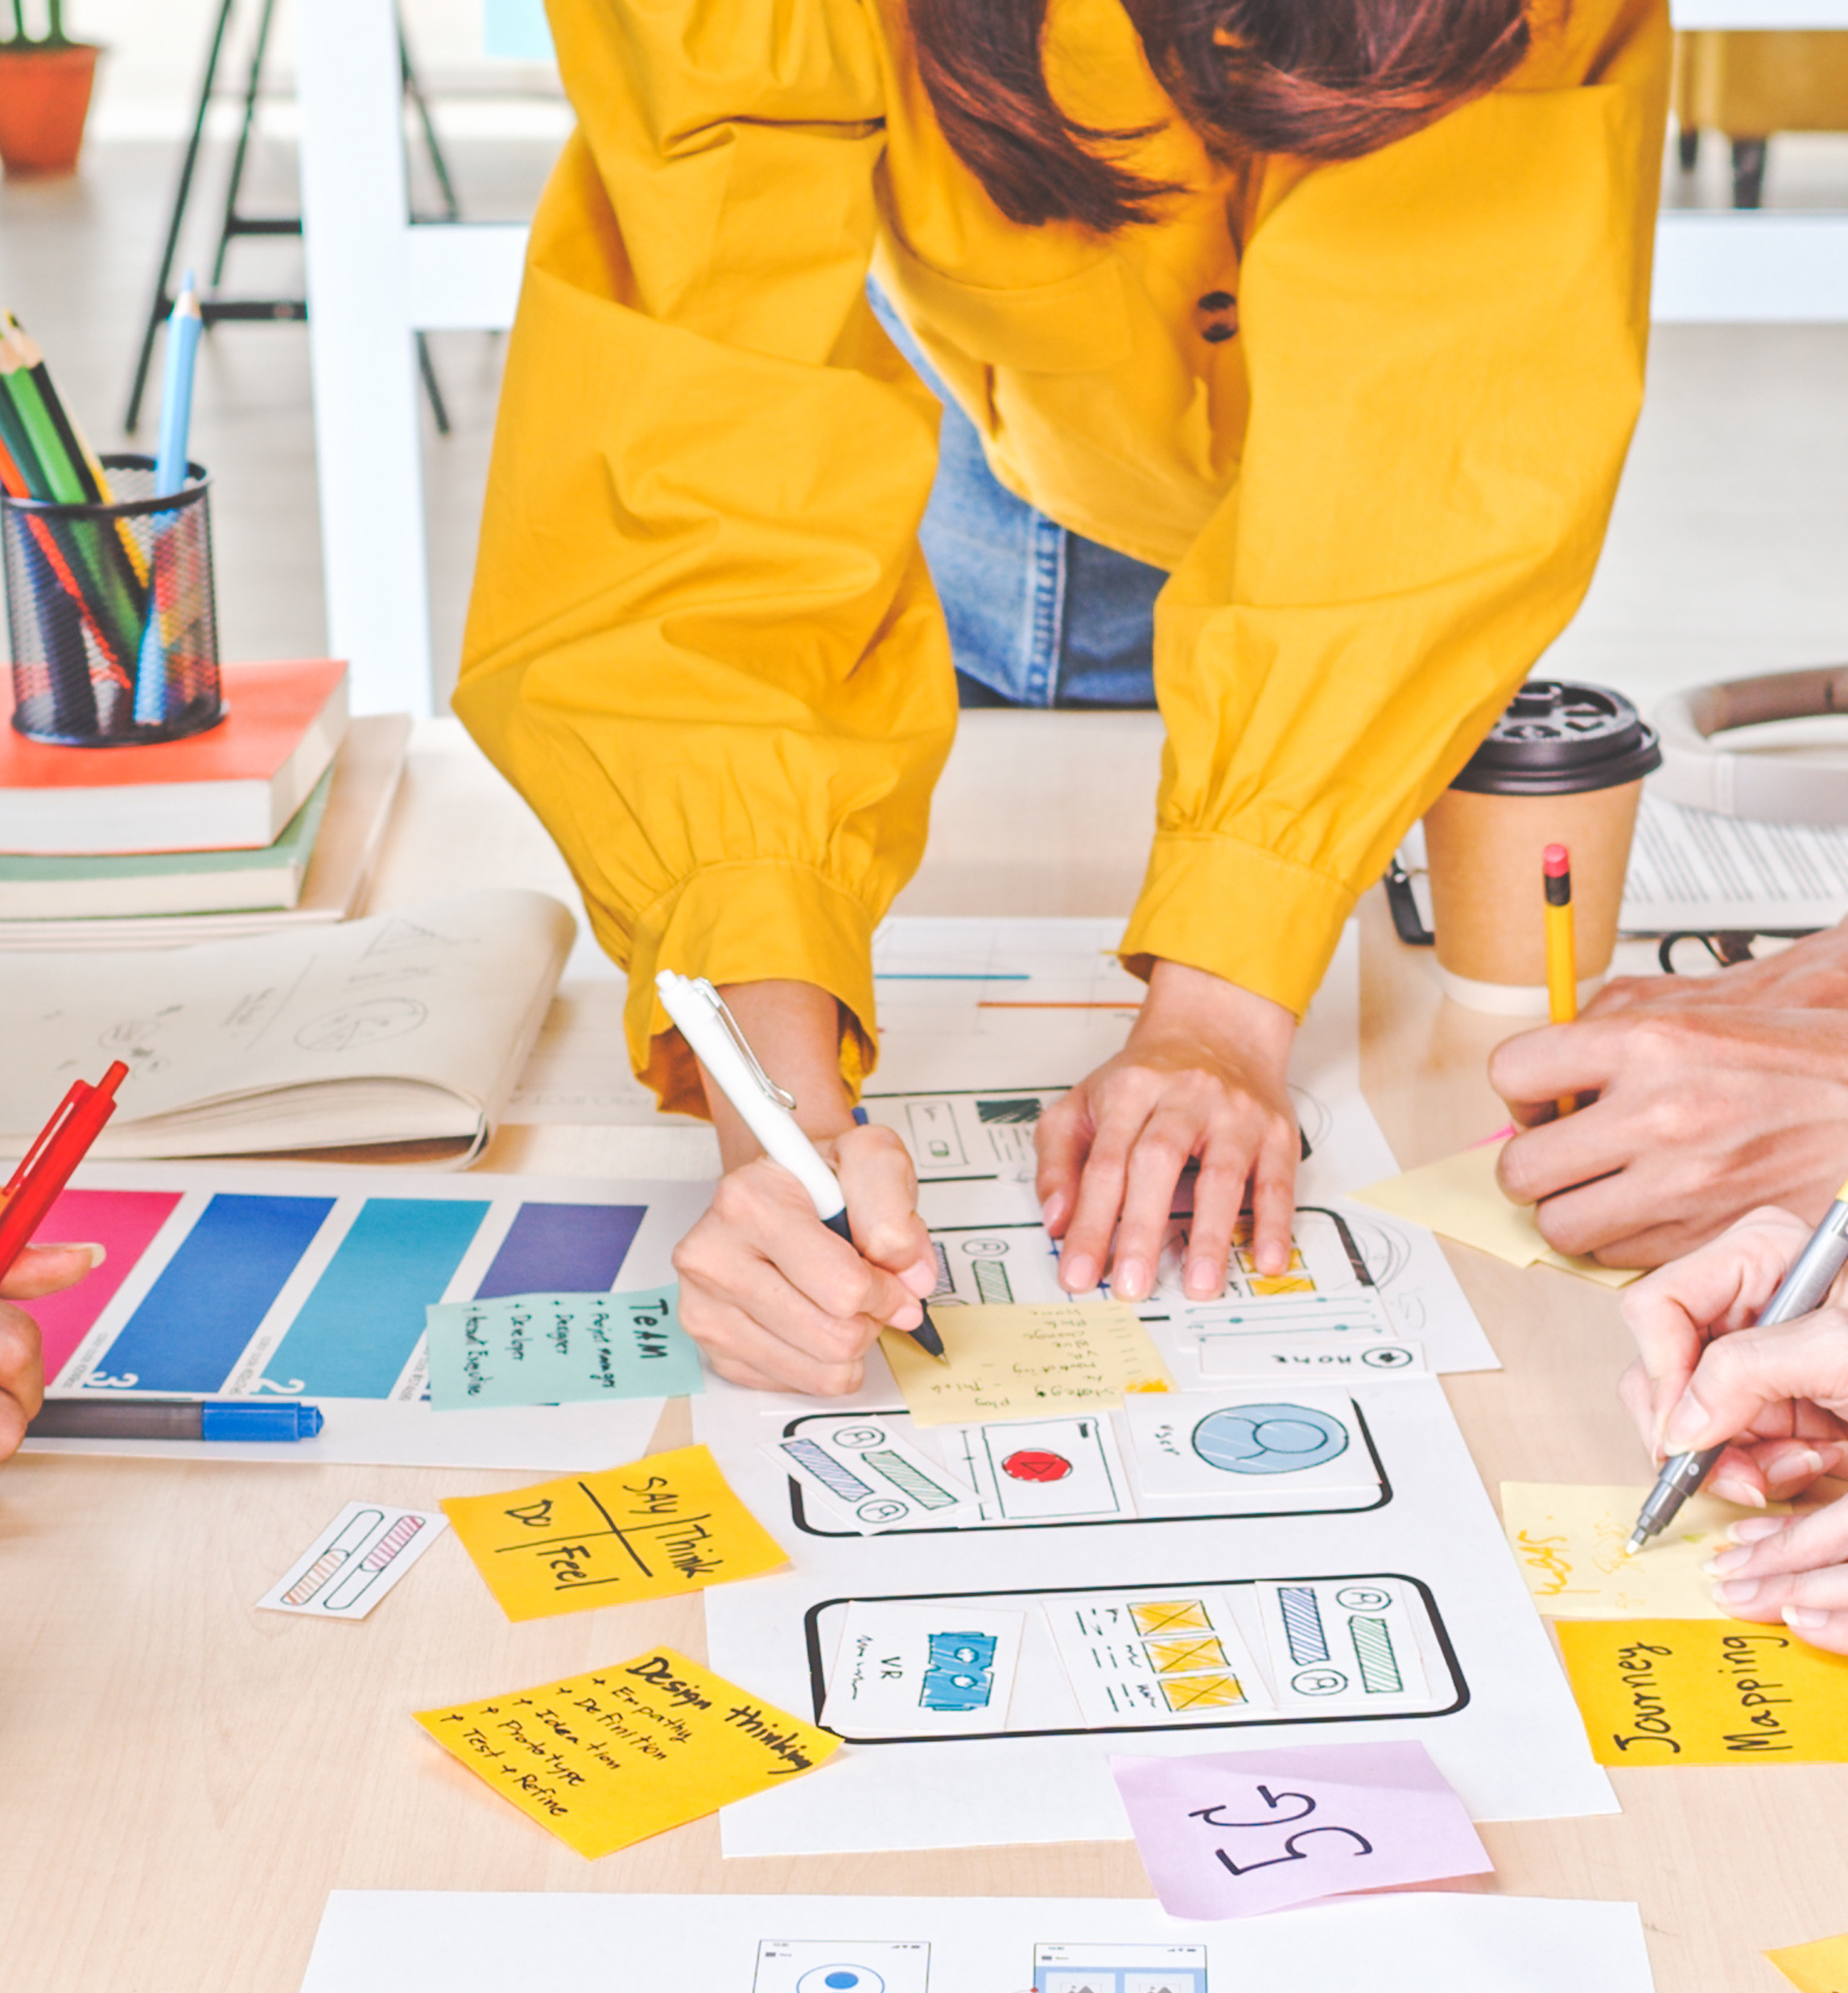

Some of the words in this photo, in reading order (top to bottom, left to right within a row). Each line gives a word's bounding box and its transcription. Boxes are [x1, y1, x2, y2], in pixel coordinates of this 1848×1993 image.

[84, 1371, 138, 1388] 3
[250, 1378, 305, 1395] 2
[505, 1499, 554, 1529] Do
[536, 1545, 621, 1591] Feel
[654, 1524, 724, 1579] Think
[626, 1656, 712, 1711] Design
[880, 1655, 903, 1681] VR
[1613, 1641, 1681, 1754] Journey
[1718, 1635, 1794, 1752] Mapping
[574, 1698, 668, 1763] Definition
[610, 1686, 697, 1744] Empathy
[463, 1727, 505, 1763] Test
[514, 1774, 569, 1818] Refine
[498, 1721, 586, 1787] Prototype
[1187, 1784, 1374, 1877] 5G
